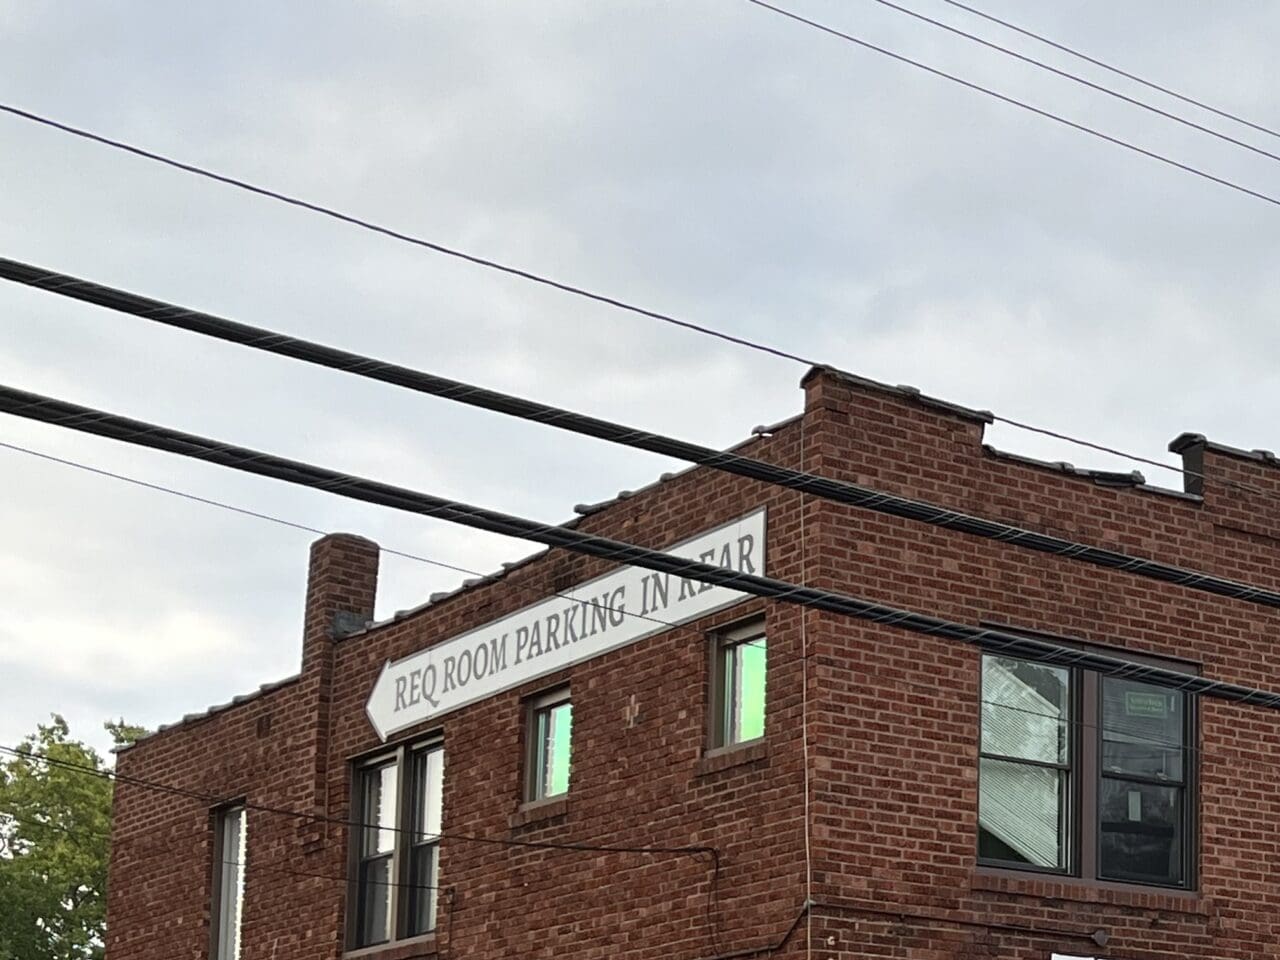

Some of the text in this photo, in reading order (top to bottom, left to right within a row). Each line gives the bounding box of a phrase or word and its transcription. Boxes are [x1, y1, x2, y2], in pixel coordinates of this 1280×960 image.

[393, 663, 441, 713] REQ
[442, 632, 509, 694] ROOM
[513, 585, 626, 667] PARKING
[640, 572, 669, 617] IN
